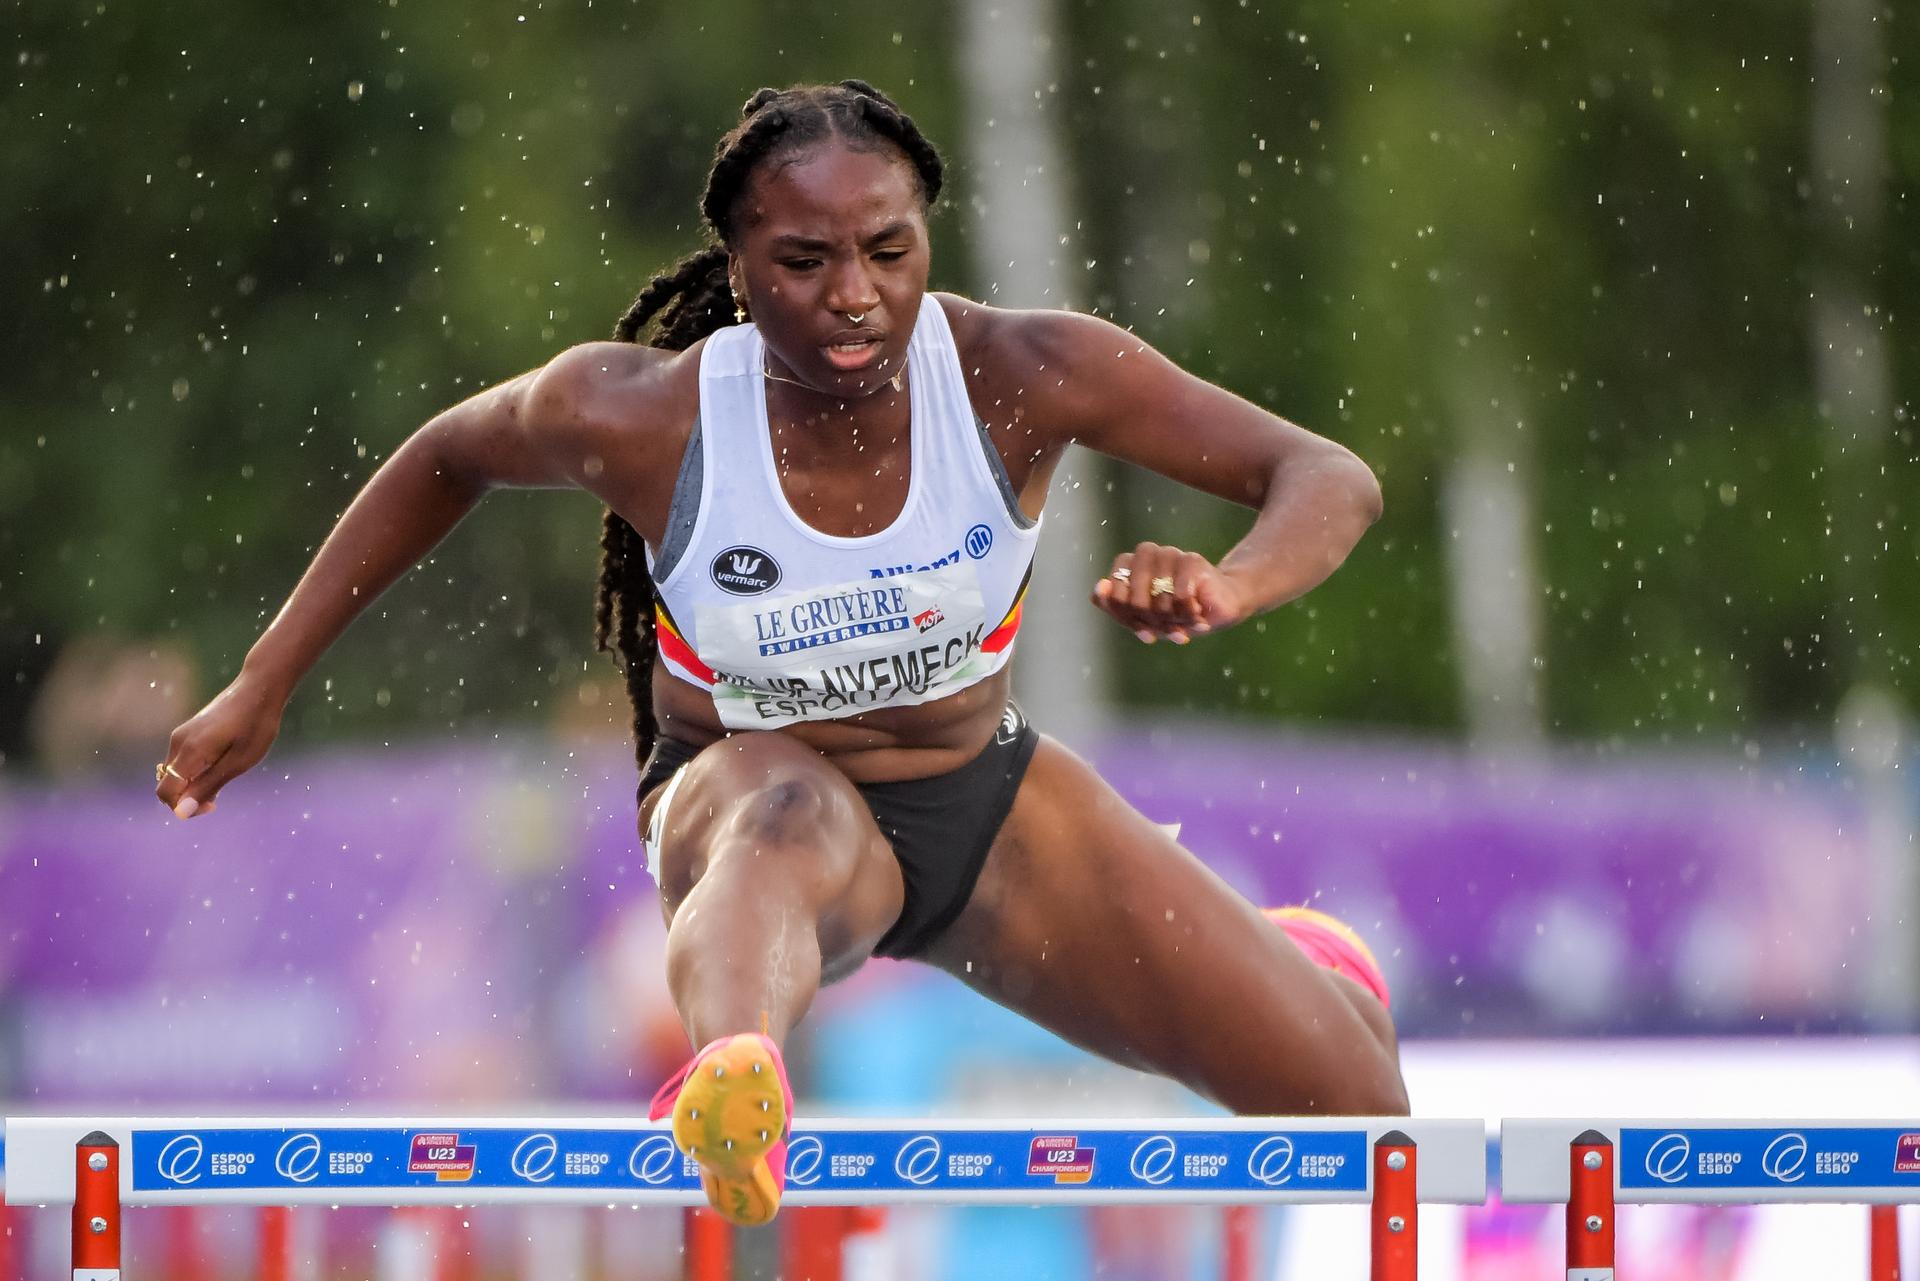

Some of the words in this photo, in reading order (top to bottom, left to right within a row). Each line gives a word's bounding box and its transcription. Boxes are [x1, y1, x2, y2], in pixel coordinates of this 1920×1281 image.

[717, 572, 768, 588] vermarc
[753, 608, 786, 641] LE
[791, 586, 908, 634] GRUYÈRE
[765, 618, 904, 656] SWITZERLAND
[211, 1153, 255, 1164] ESPOO
[329, 1152, 373, 1163] ESPOO
[428, 1147, 456, 1160] U23
[565, 1153, 609, 1164] ESPOO
[1047, 1150, 1075, 1163] U23
[1698, 1153, 1742, 1164] ESPOO
[1815, 1152, 1859, 1163] ESPOO
[831, 1155, 875, 1166] ESPOO
[948, 1155, 993, 1166] ESPOO
[1183, 1155, 1228, 1166] ESPOO
[1301, 1155, 1345, 1166] ESPOO
[211, 1164, 247, 1175] ESBO
[329, 1163, 364, 1174] ESBO
[565, 1164, 600, 1175] ESBO
[683, 1166, 699, 1176] ES
[831, 1166, 866, 1177] ESBO
[948, 1166, 984, 1177] ESBO
[1031, 1165, 1089, 1173] CHAMPIONSHIPS
[1183, 1166, 1219, 1177] ESBO
[1301, 1166, 1336, 1177] ESBO
[1698, 1164, 1733, 1174] ESBO
[1815, 1163, 1850, 1174] ESBO
